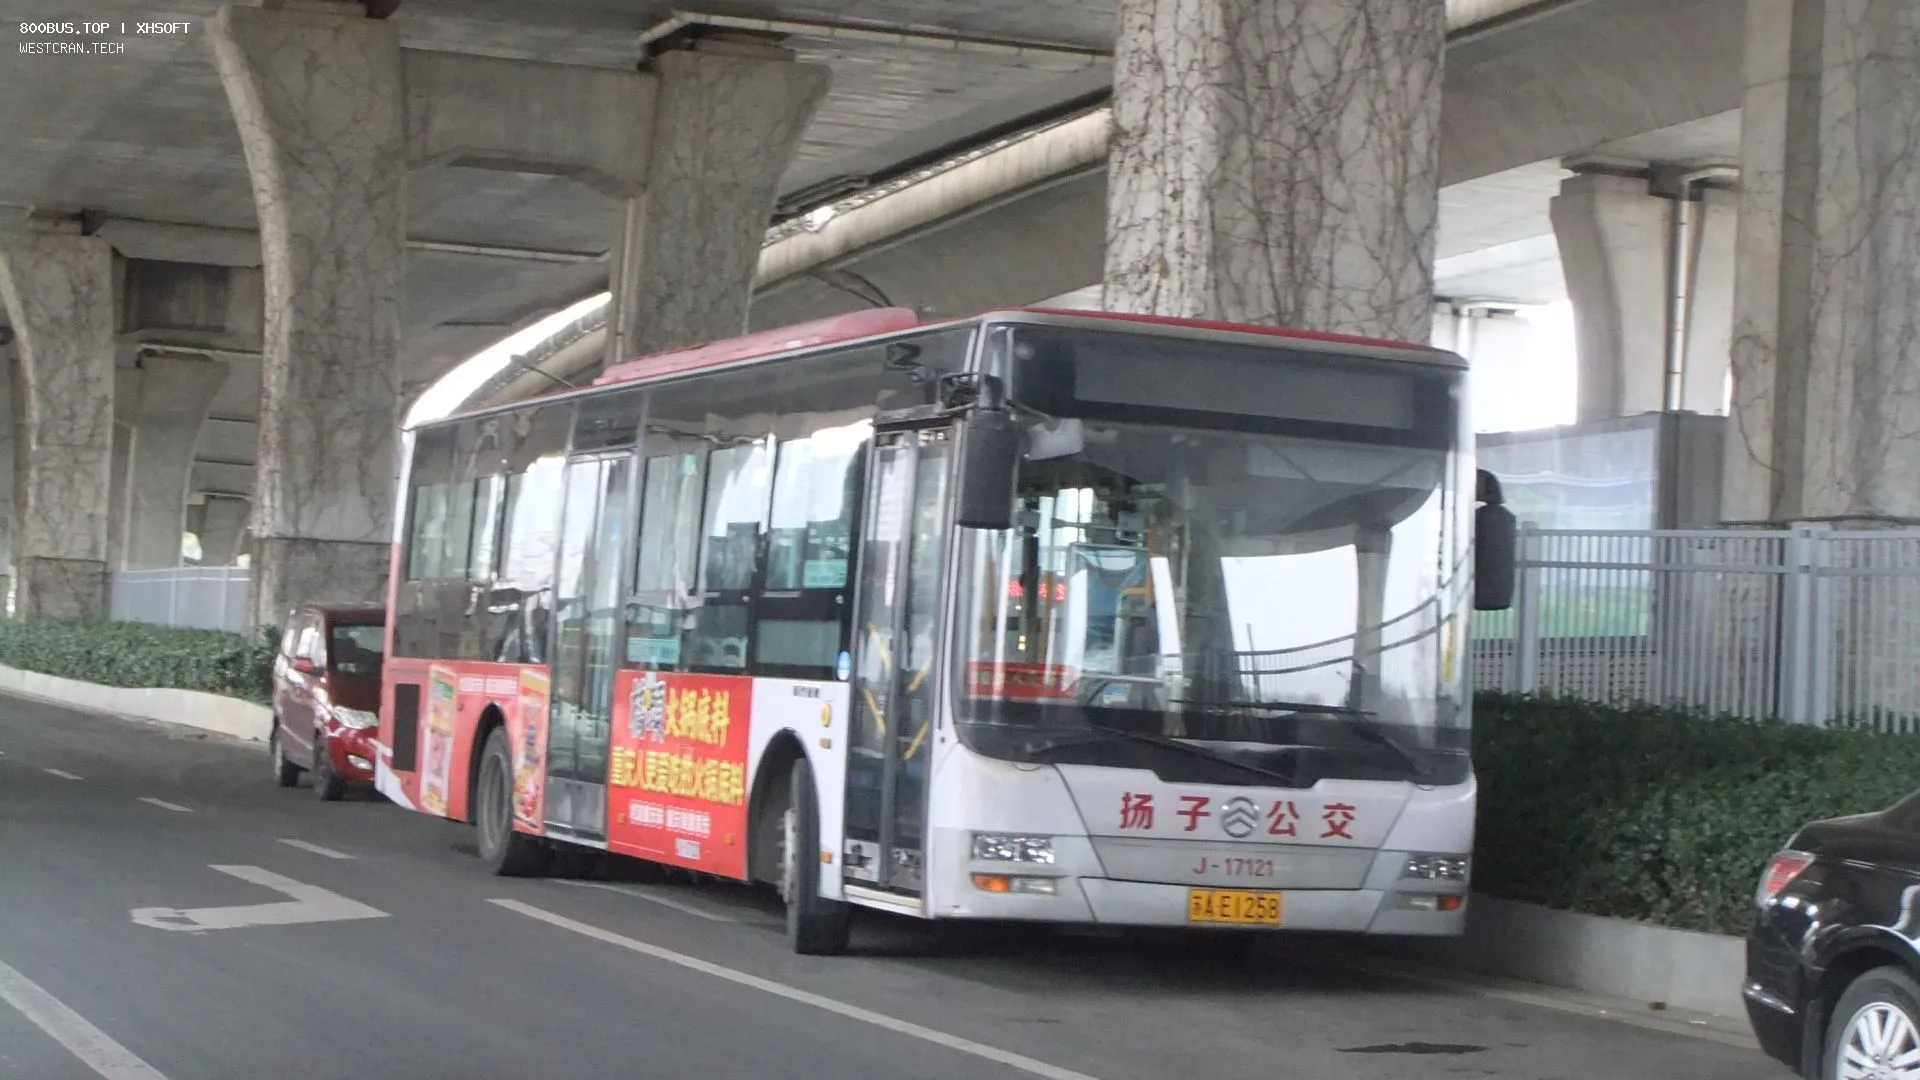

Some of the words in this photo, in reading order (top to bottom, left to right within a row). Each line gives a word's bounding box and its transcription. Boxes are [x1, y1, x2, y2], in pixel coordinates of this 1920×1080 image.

[665, 687, 730, 748] 火锅底料
[1119, 791, 1212, 832] 扬子
[1266, 800, 1357, 840] 公交
[1193, 856, 1275, 877] J-17121
